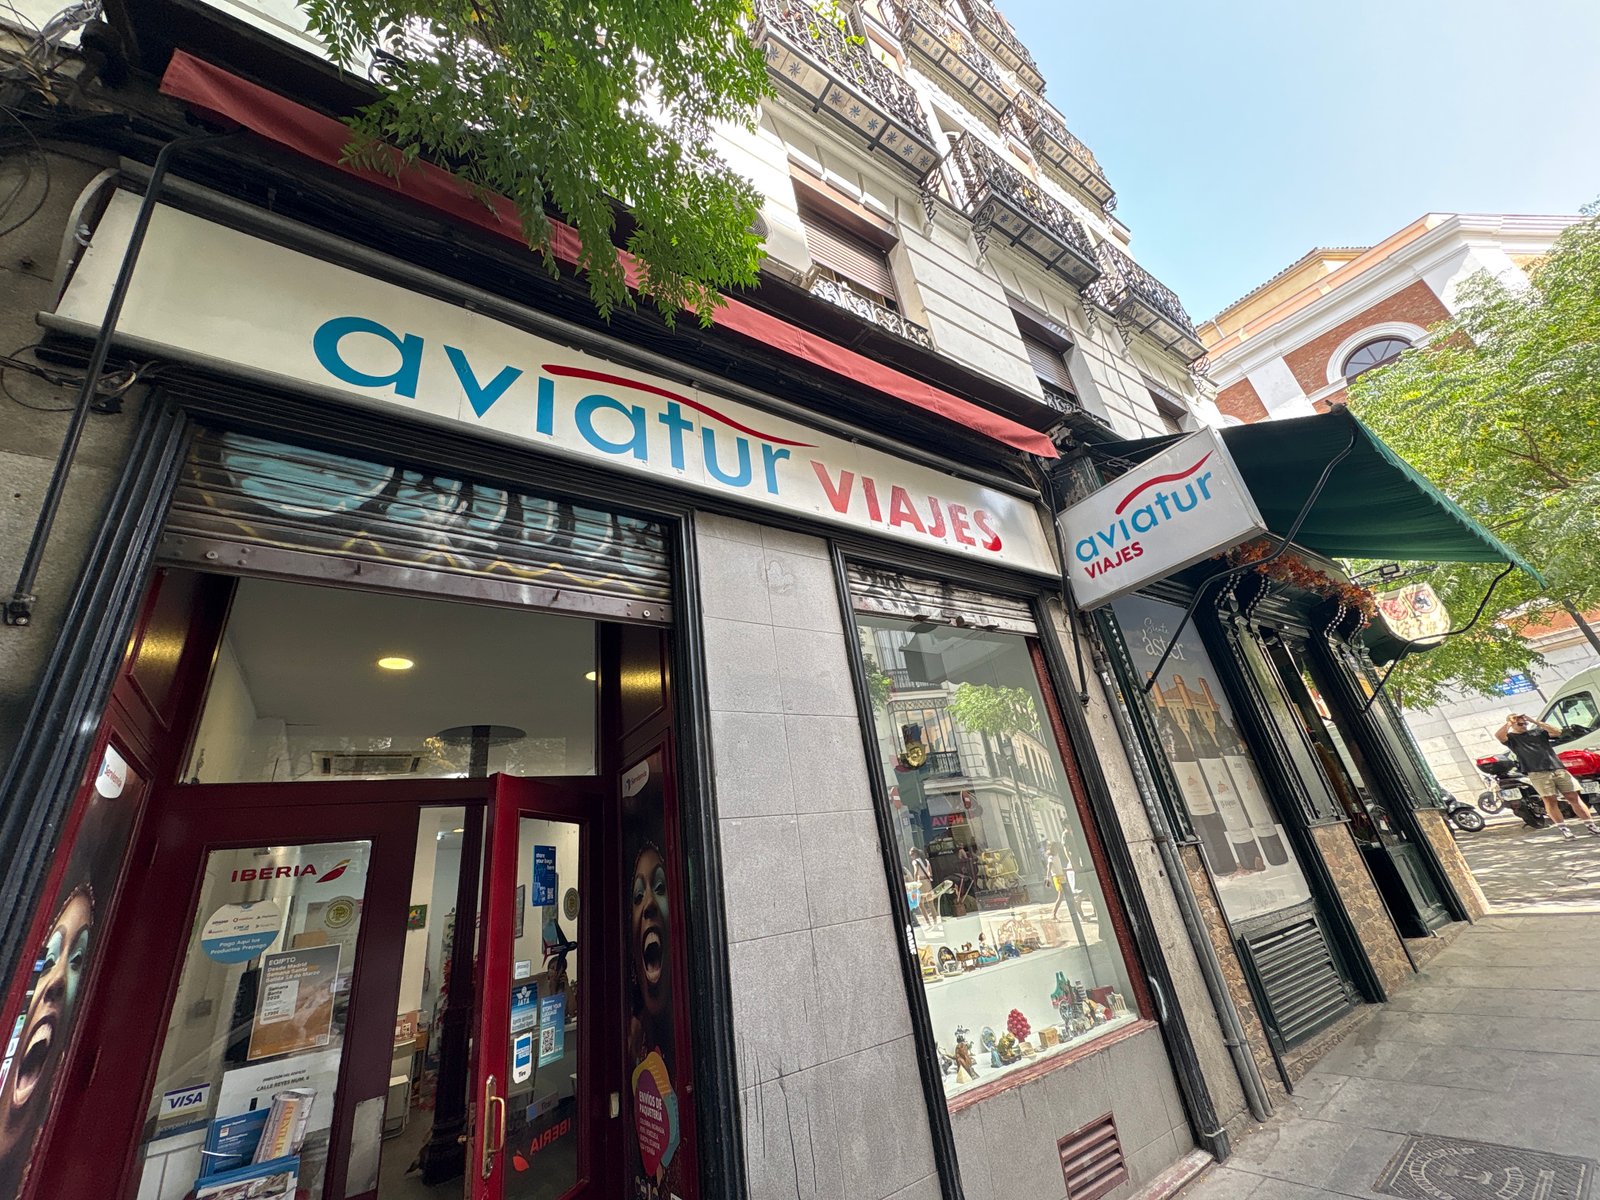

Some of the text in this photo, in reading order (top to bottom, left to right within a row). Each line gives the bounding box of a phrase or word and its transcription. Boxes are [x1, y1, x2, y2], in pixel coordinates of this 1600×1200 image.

[313, 316, 791, 496] aviatur
[811, 460, 1003, 553] VIAJES
[1075, 471, 1212, 562] aviatur
[1084, 541, 1144, 579] VIAJES
[231, 864, 317, 882] IBERIA
[268, 956, 296, 966] EGIPTO
[256, 1083, 273, 1092] CALLE
[168, 1092, 203, 1109] VISA
[655, 1097, 663, 1110] DE
